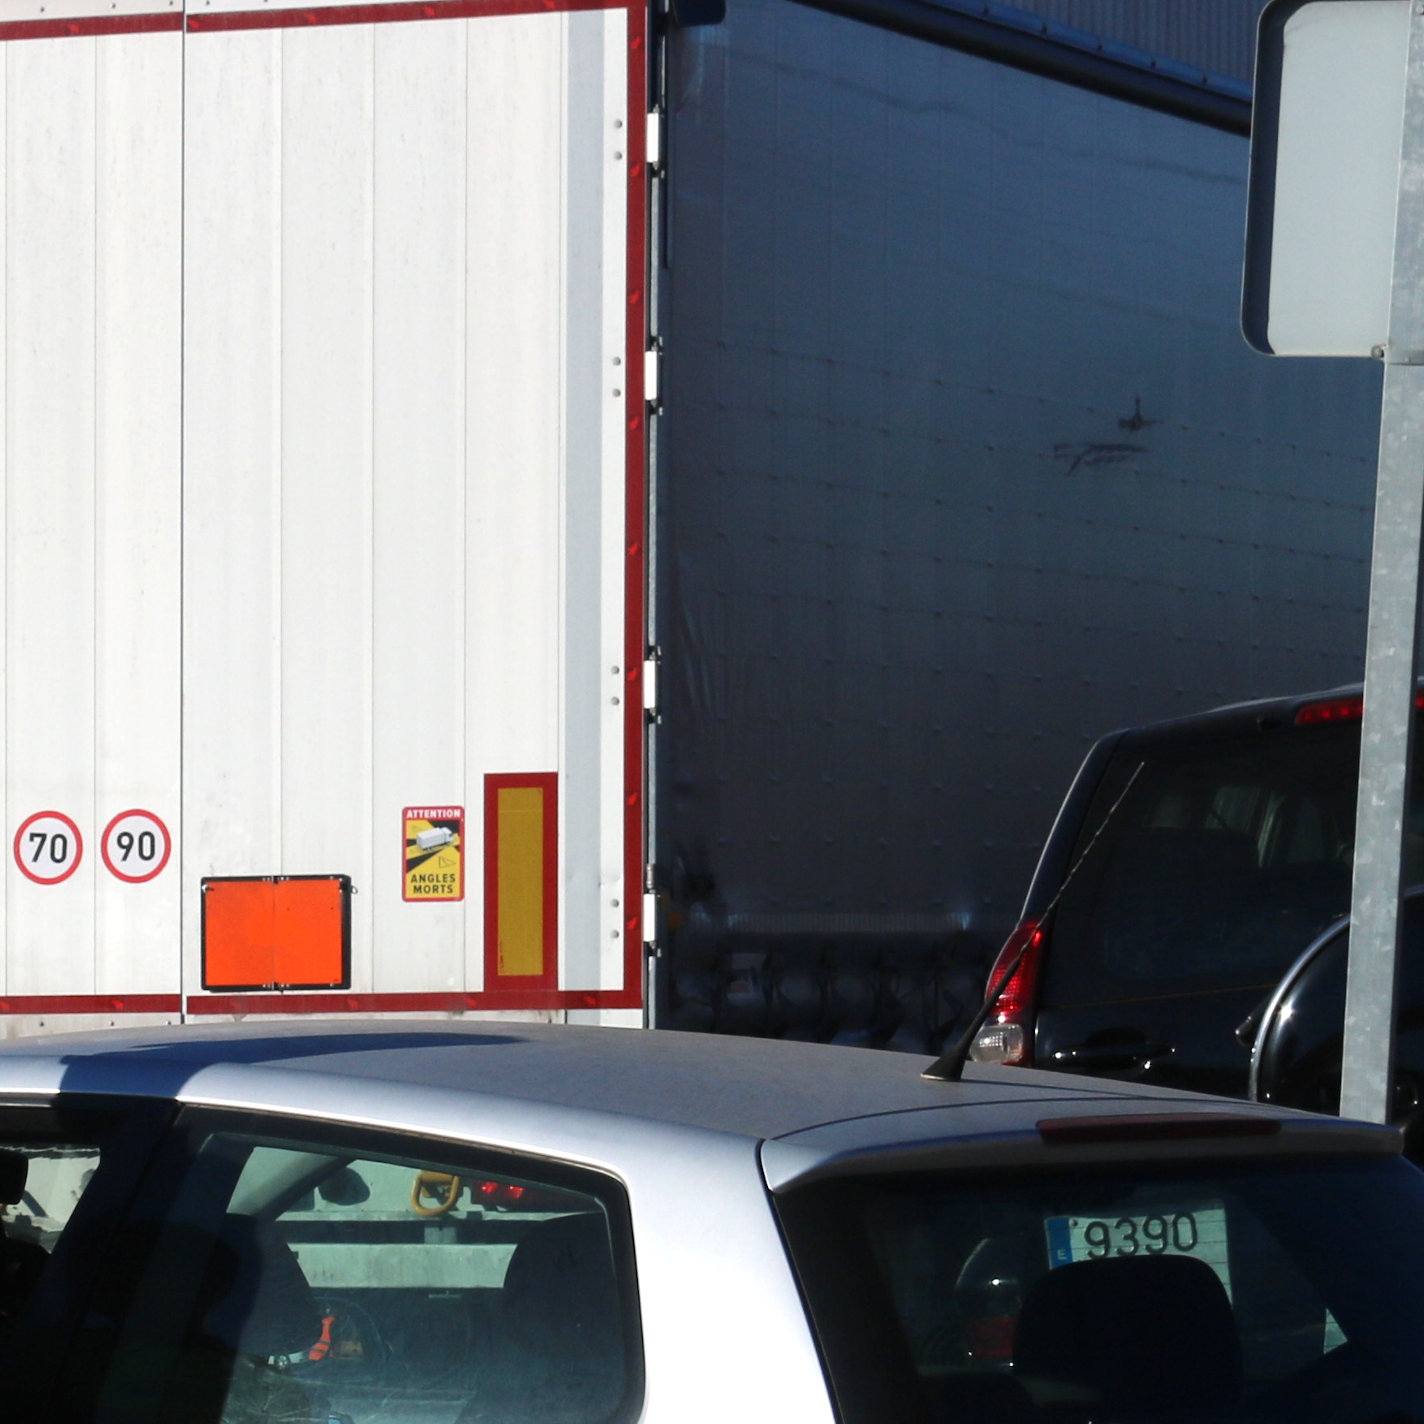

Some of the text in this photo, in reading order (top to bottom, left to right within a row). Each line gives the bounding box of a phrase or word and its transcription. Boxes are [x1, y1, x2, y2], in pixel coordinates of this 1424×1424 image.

[406, 808, 461, 819] ATTENTION
[28, 832, 68, 864] 70
[116, 830, 156, 862] 90
[410, 873, 456, 884] ANGLES
[413, 884, 454, 895] MORTS
[1083, 1211, 1199, 1260] 9390
